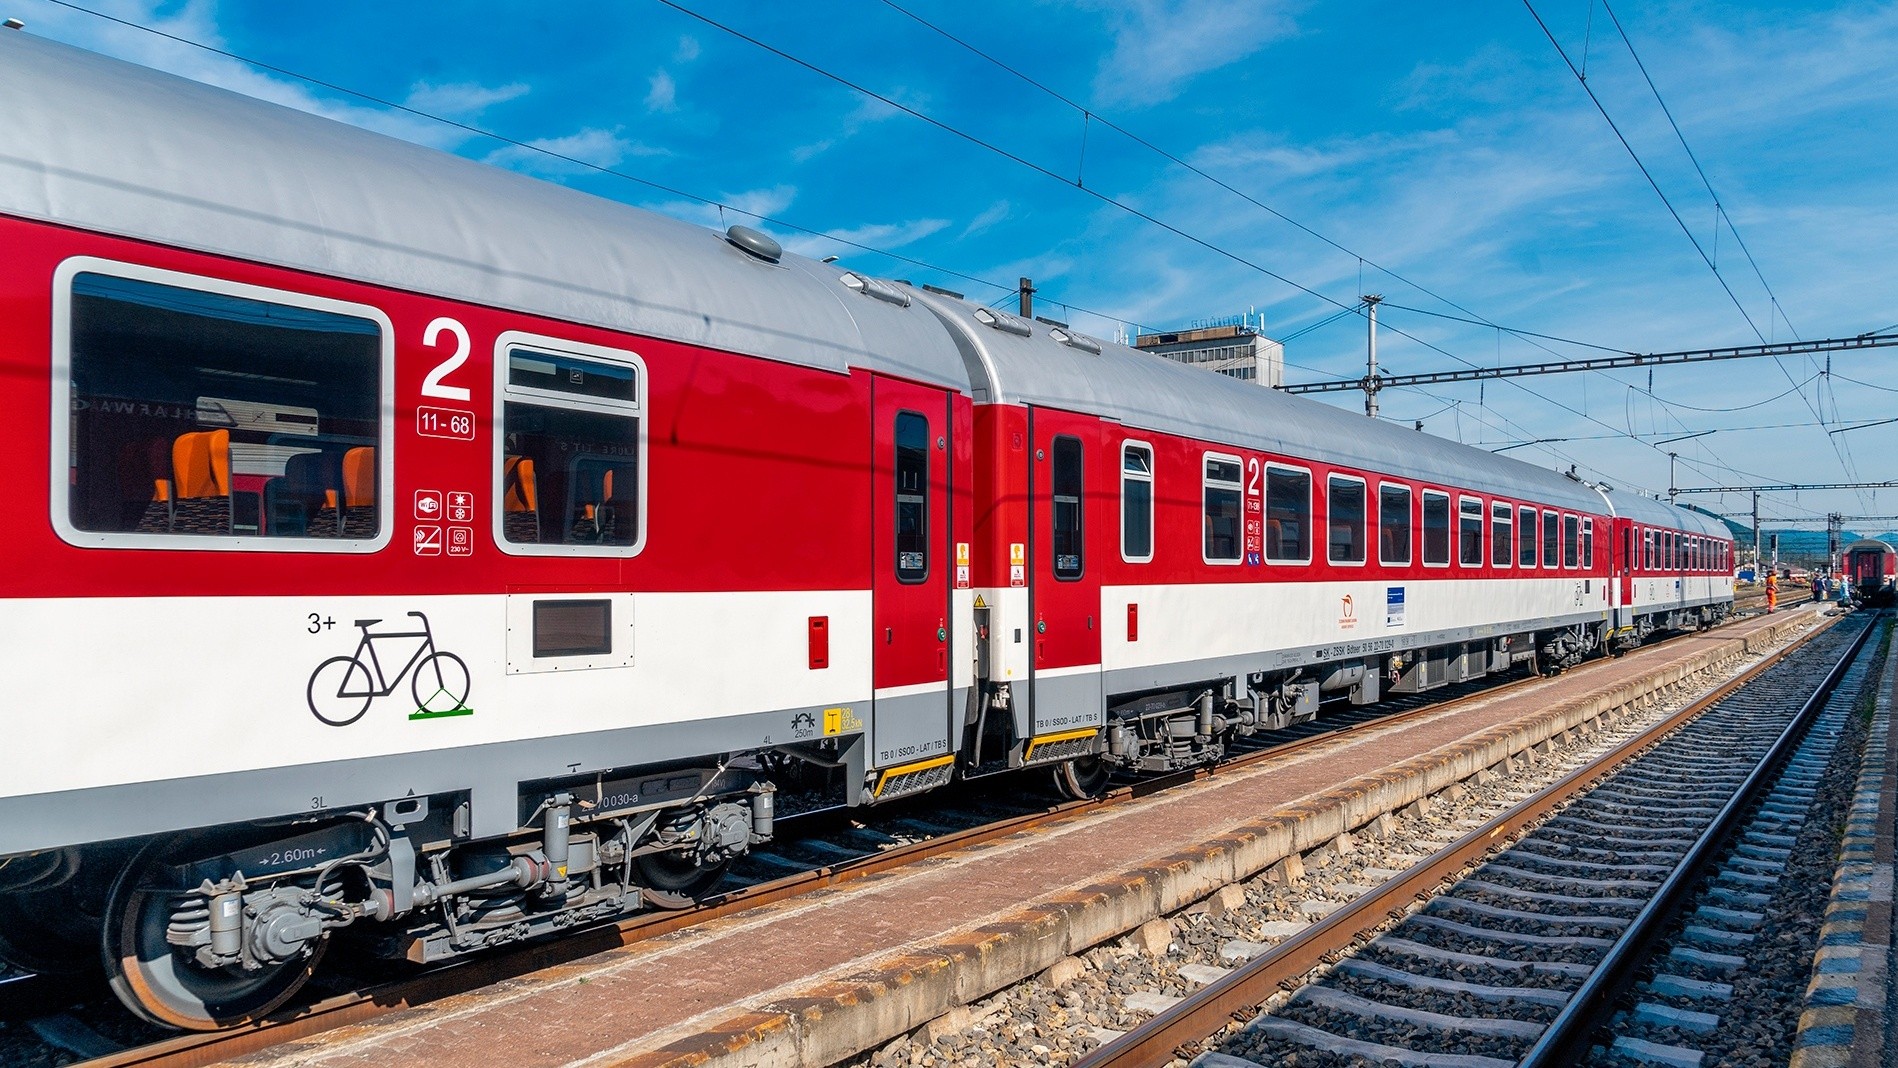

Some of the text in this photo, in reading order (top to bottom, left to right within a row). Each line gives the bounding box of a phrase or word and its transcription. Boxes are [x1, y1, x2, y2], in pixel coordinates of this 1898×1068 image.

[420, 316, 471, 402] 2
[1247, 457, 1260, 496] 2
[450, 545, 460, 553] 230
[307, 612, 336, 634] 3+
[763, 735, 773, 745] 4L
[794, 728, 814, 738] 250m
[880, 750, 889, 760] TB
[920, 742, 930, 752] LAT
[311, 796, 328, 809] 3L
[270, 848, 315, 865] 2.60m
